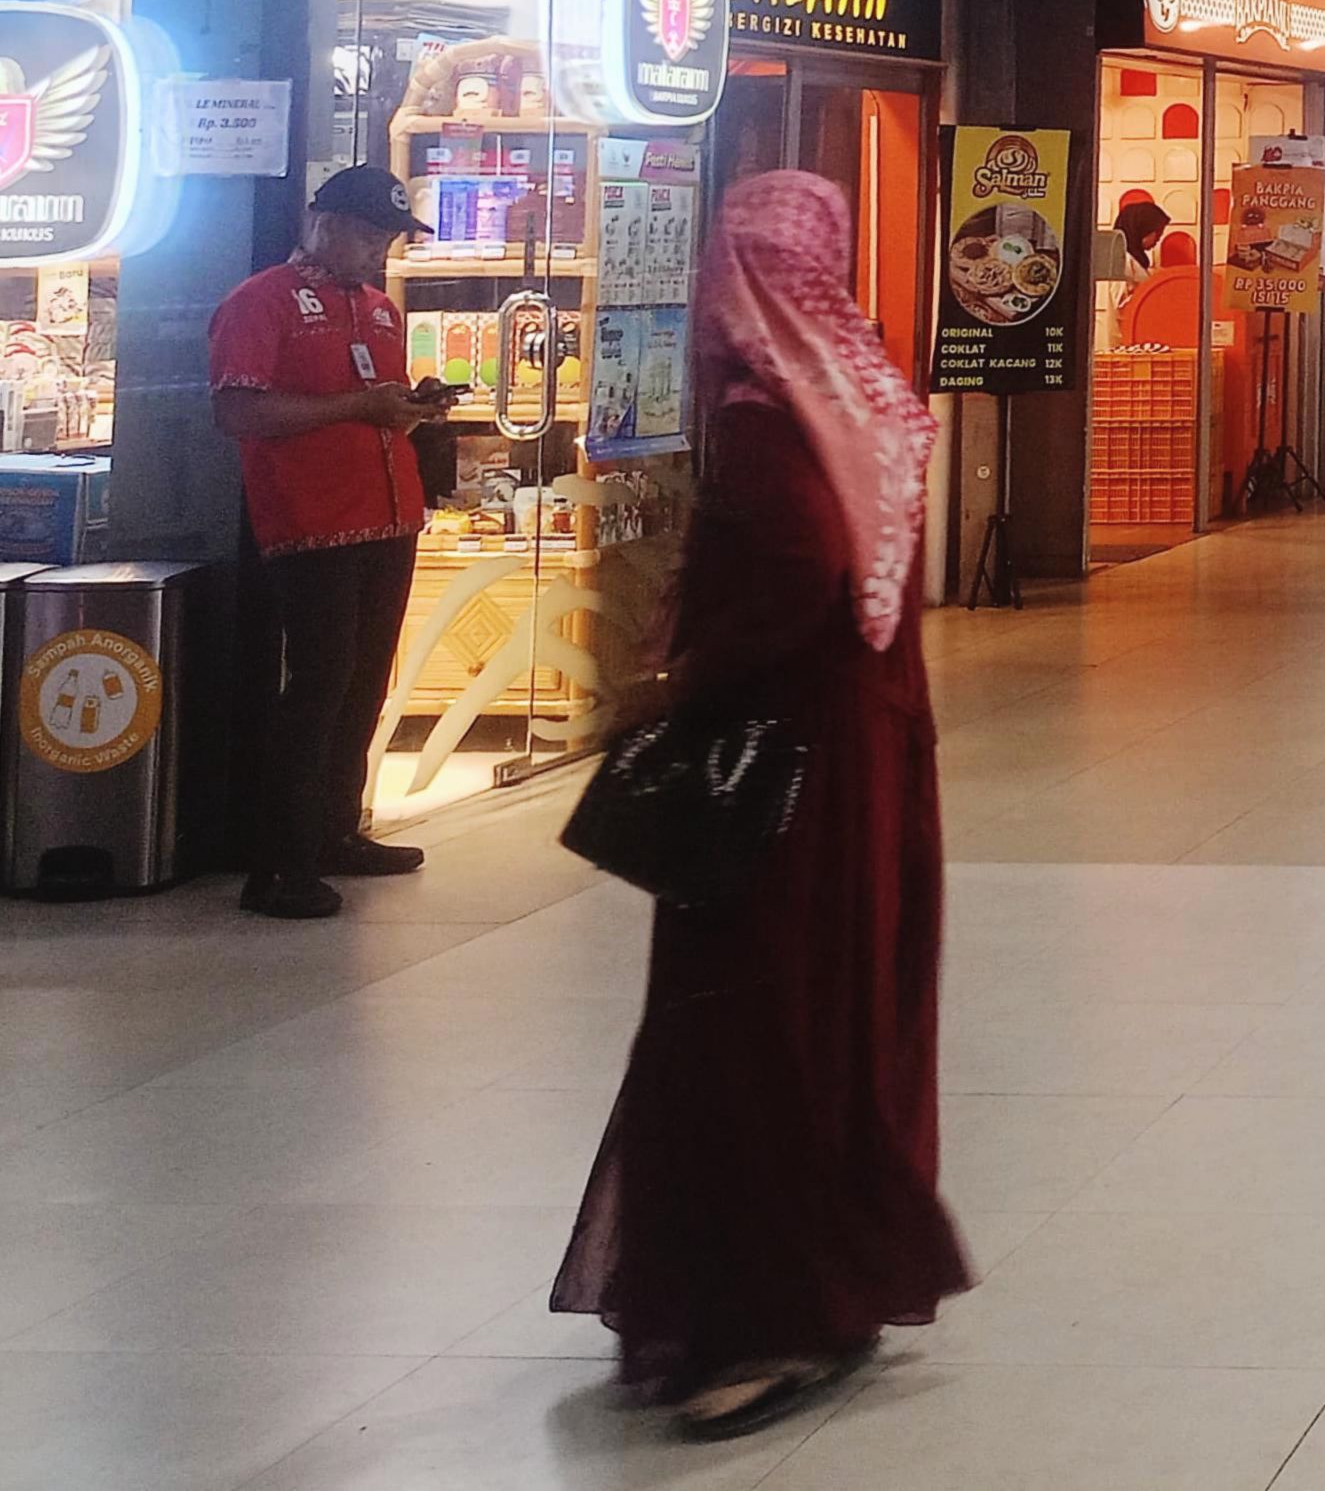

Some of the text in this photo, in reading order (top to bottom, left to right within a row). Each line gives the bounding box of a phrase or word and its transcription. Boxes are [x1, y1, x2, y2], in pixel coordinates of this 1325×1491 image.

[812, 22, 907, 49] KESEHATAN
[973, 166, 1048, 199] Salman
[1256, 181, 1304, 195] BAKPIA
[1242, 194, 1316, 209] PANGGANG
[941, 327, 1064, 338] ORIGINAL 10K
[941, 344, 987, 354] COKLAT
[940, 358, 1063, 368] COKLAT KACANG 12K
[939, 374, 1063, 387] DAGING 13K
[28, 633, 158, 693] Sampah Anorganik
